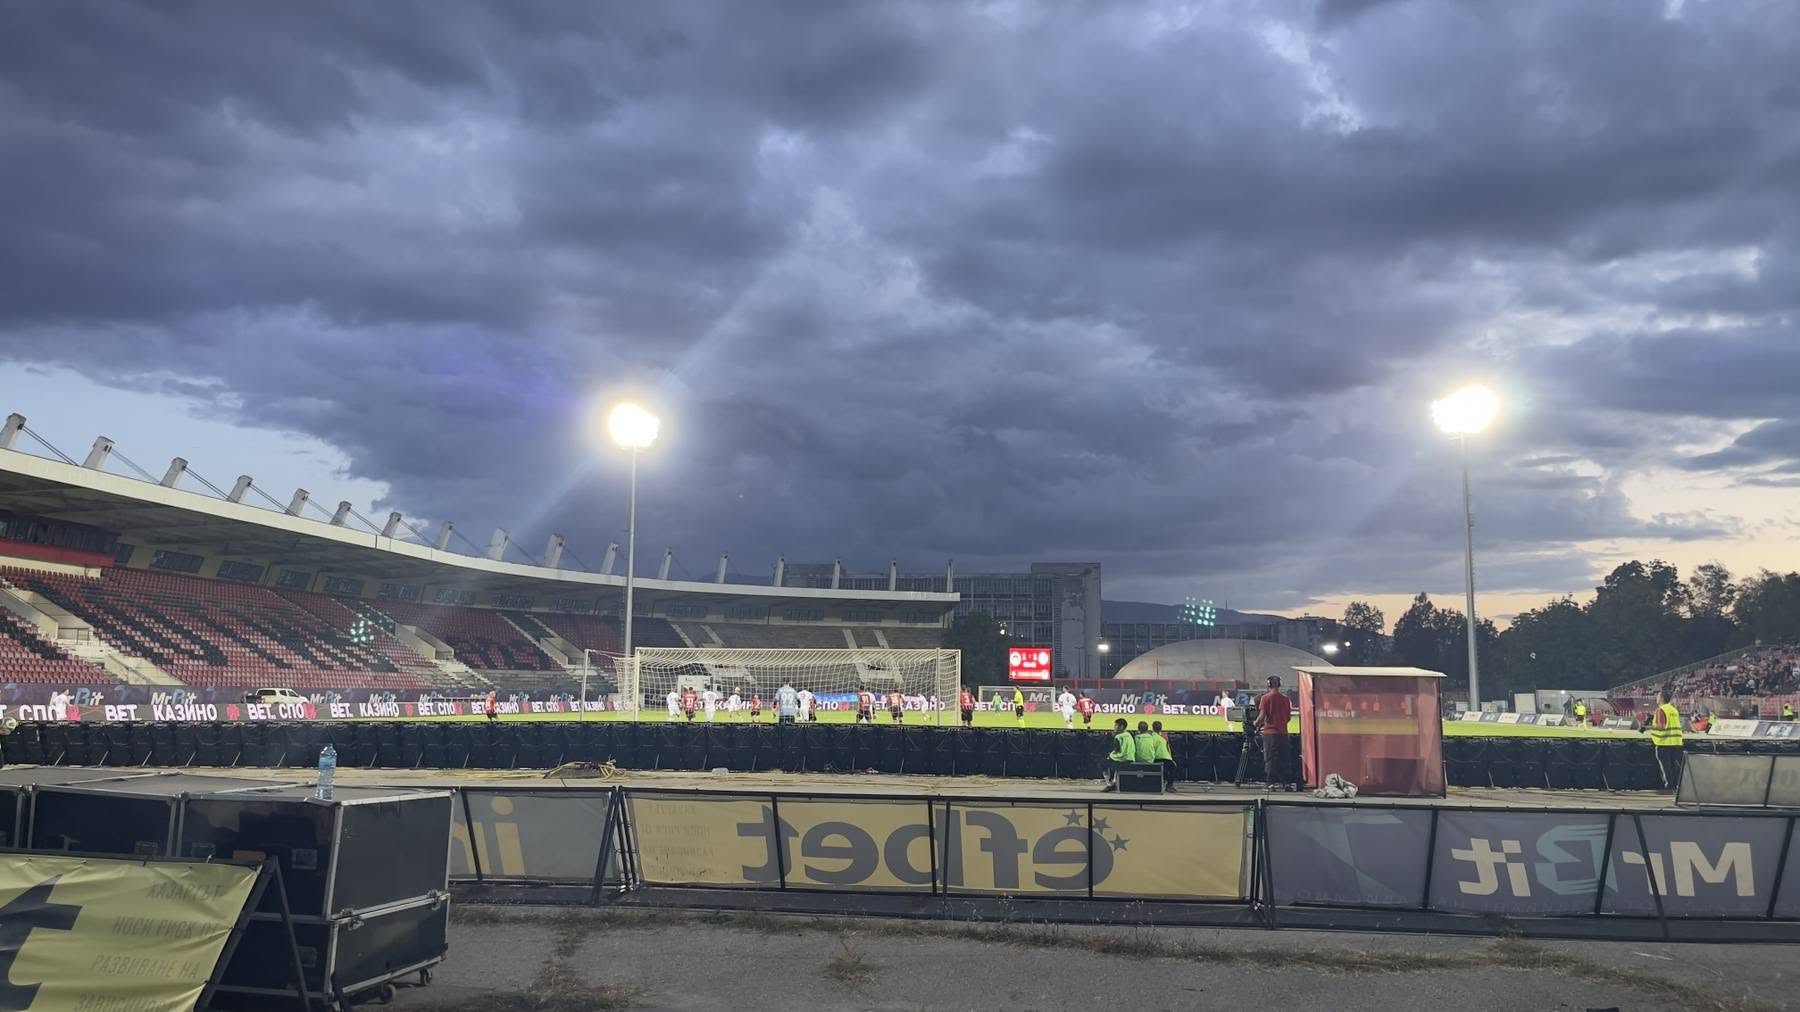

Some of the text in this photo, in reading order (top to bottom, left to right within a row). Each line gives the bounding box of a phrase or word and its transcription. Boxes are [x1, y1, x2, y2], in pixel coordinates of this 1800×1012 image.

[151, 688, 197, 705] MrBit
[310, 690, 342, 704] MrBit
[369, 690, 396, 703] MrBit
[1120, 692, 1168, 705] MrBit
[153, 703, 218, 721] КАЗИНО
[359, 702, 399, 717] КАЗИНО
[1094, 703, 1136, 713] АЗИНО
[1192, 704, 1218, 715] СПО
[181, 959, 200, 978] НА
